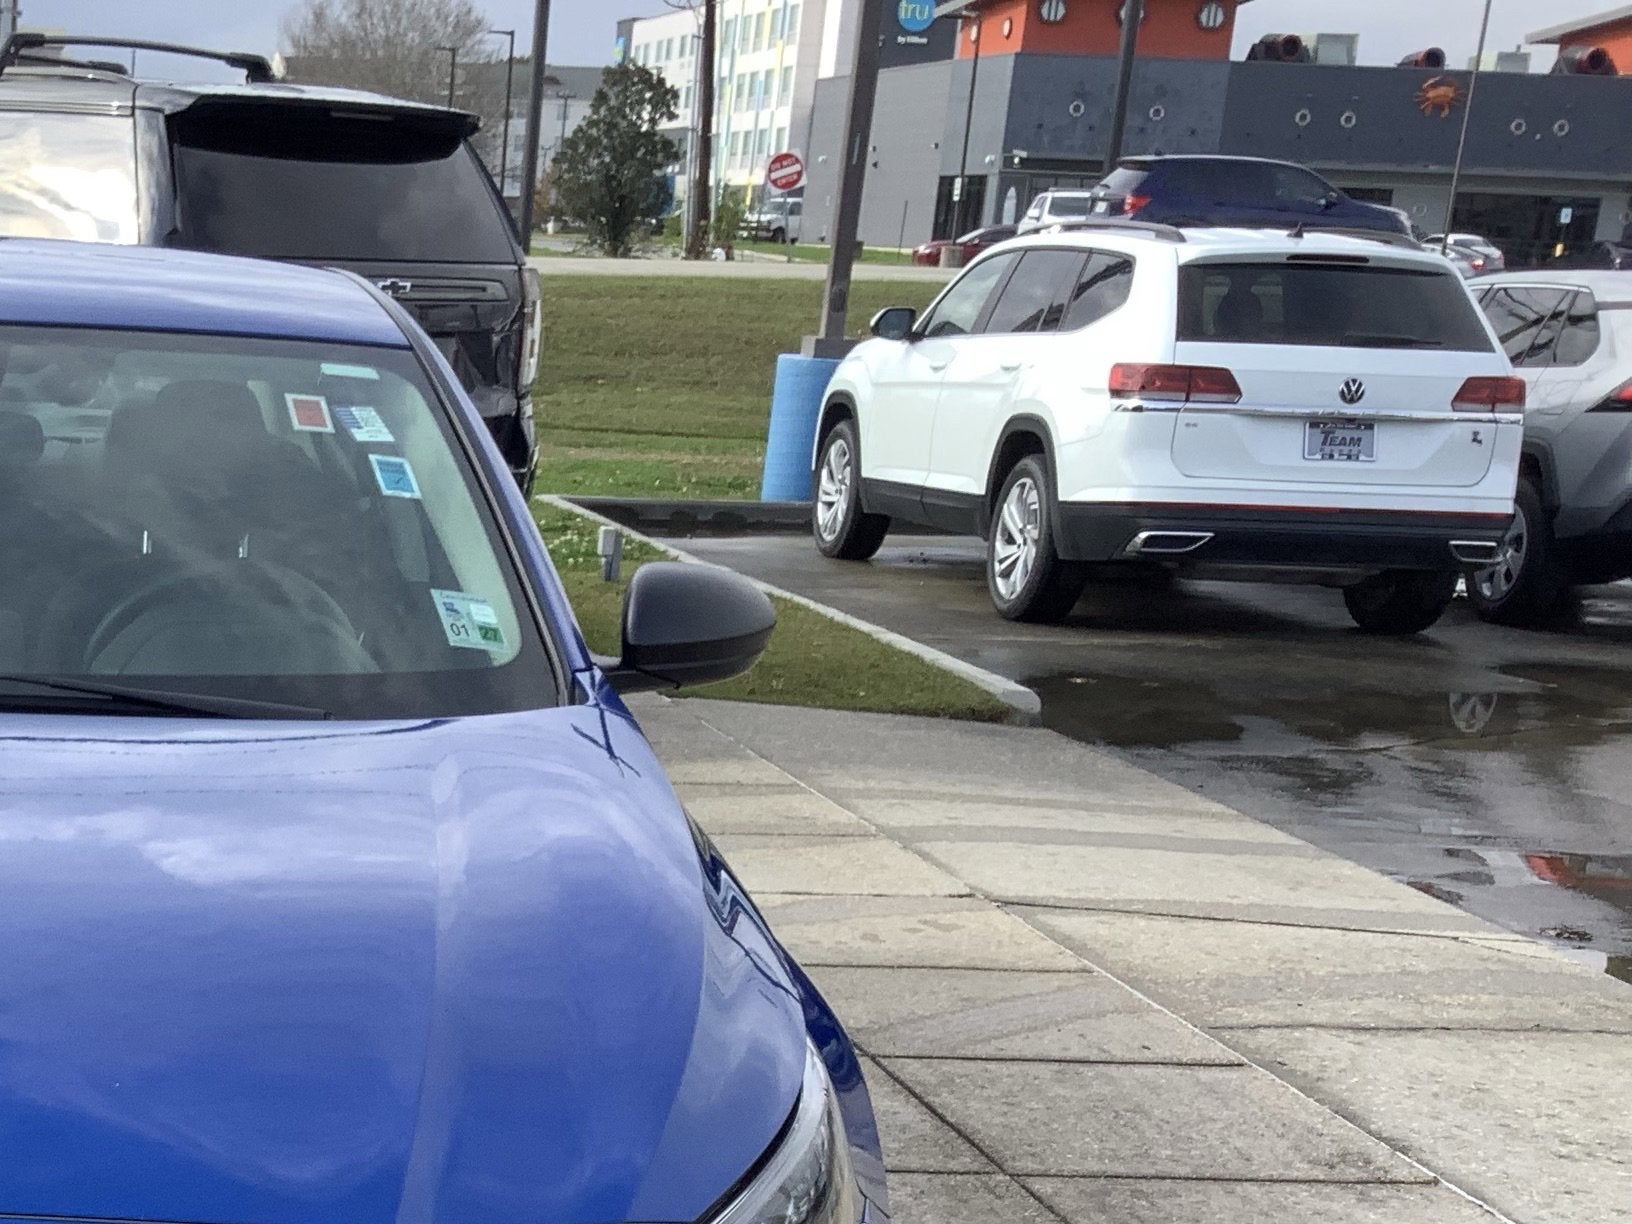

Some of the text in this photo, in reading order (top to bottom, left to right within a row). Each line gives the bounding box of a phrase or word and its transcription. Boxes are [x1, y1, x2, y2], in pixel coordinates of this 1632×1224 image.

[898, 0, 929, 21] tru
[1320, 429, 1362, 448] TEAM
[449, 622, 470, 637] 01
